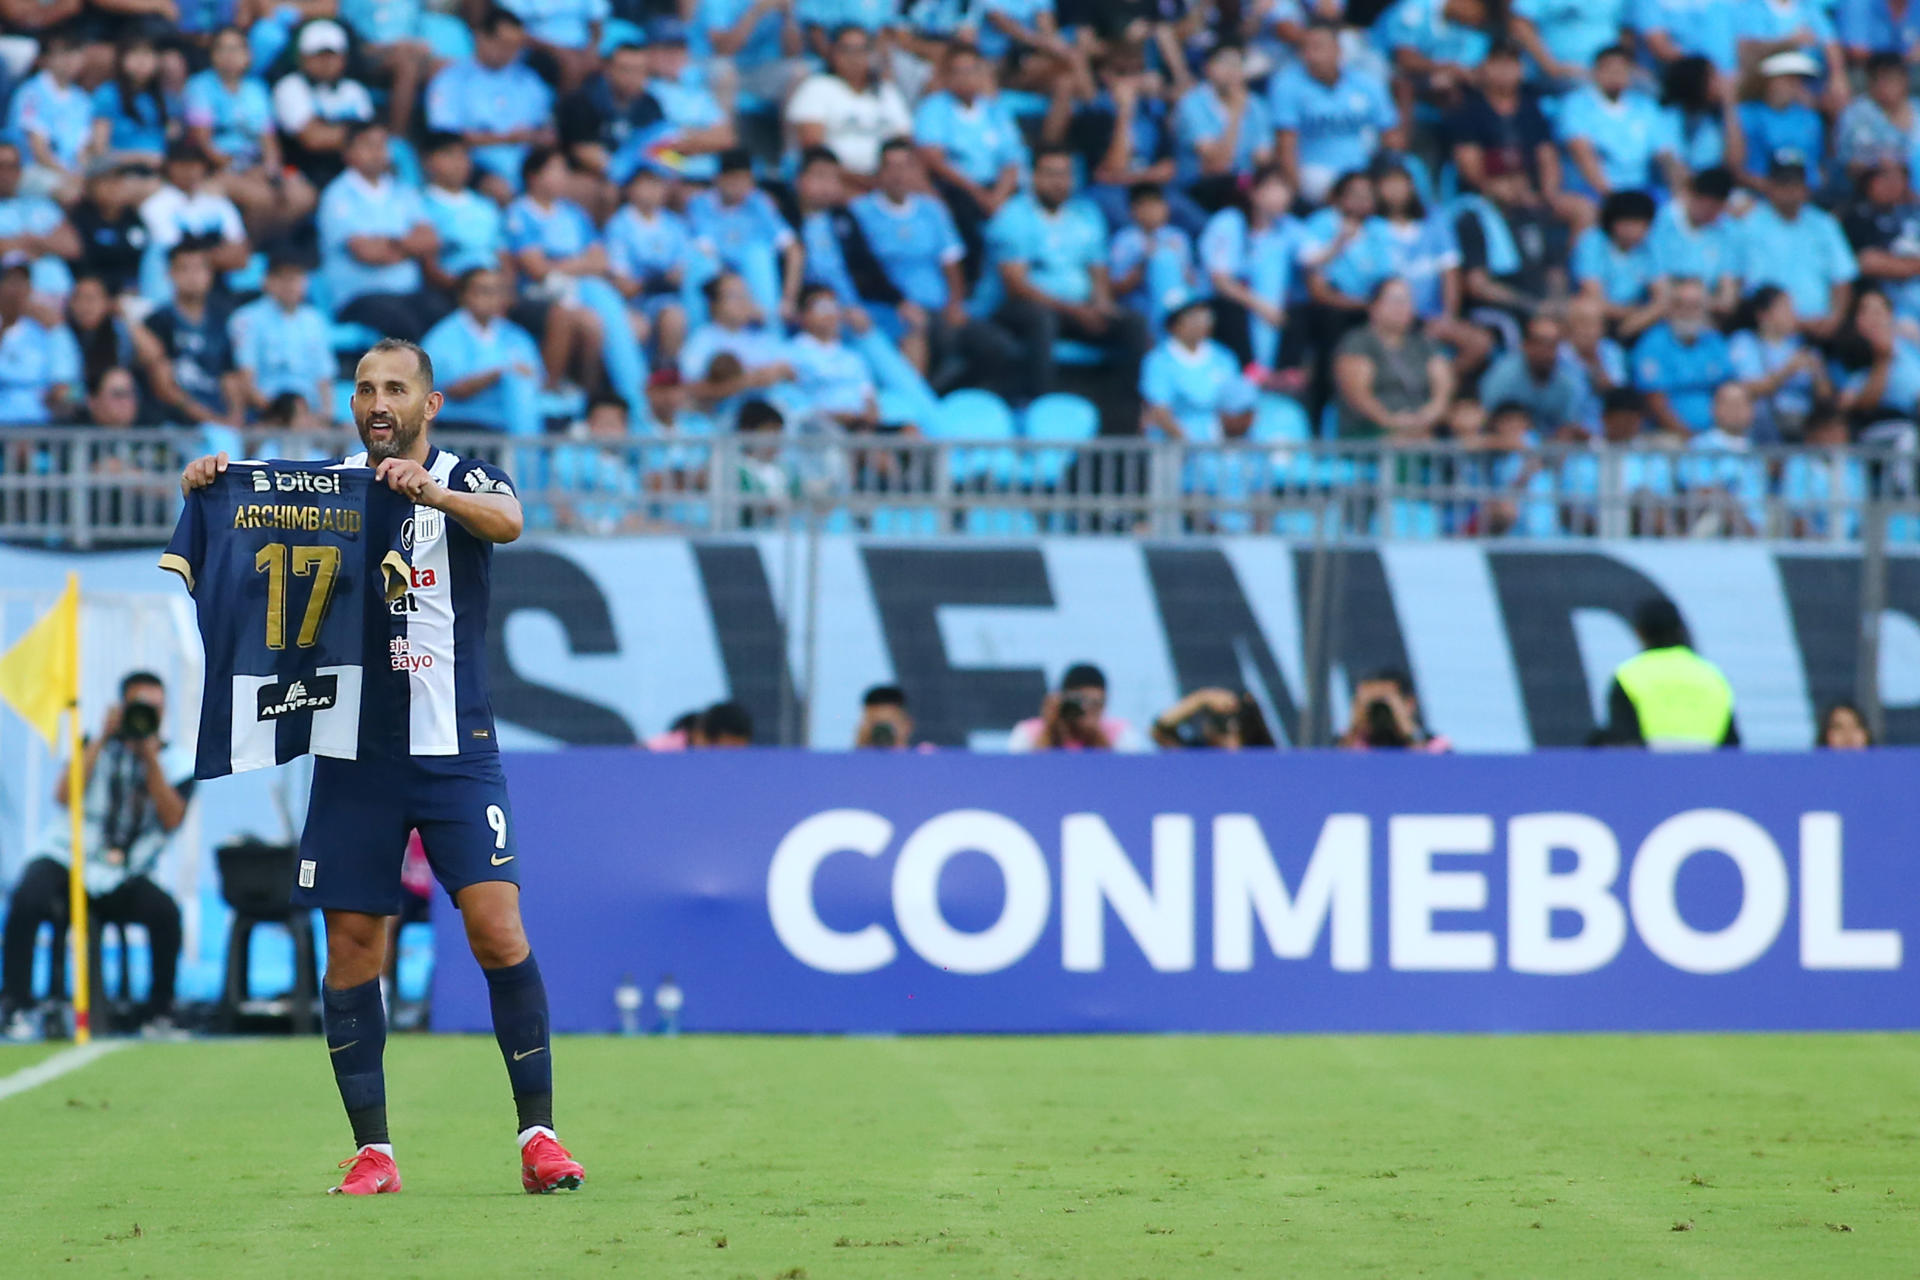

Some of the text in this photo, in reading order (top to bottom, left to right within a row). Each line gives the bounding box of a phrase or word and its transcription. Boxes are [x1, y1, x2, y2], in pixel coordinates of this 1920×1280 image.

[274, 471, 340, 494] bitel
[234, 504, 361, 532] ARCHIMBAUD
[255, 543, 341, 650] 17
[389, 637, 410, 653] aja
[391, 654, 433, 672] cayo
[262, 696, 331, 716] ANYPSA
[486, 804, 507, 849] 9
[767, 808, 1902, 974] CONMEBOL
